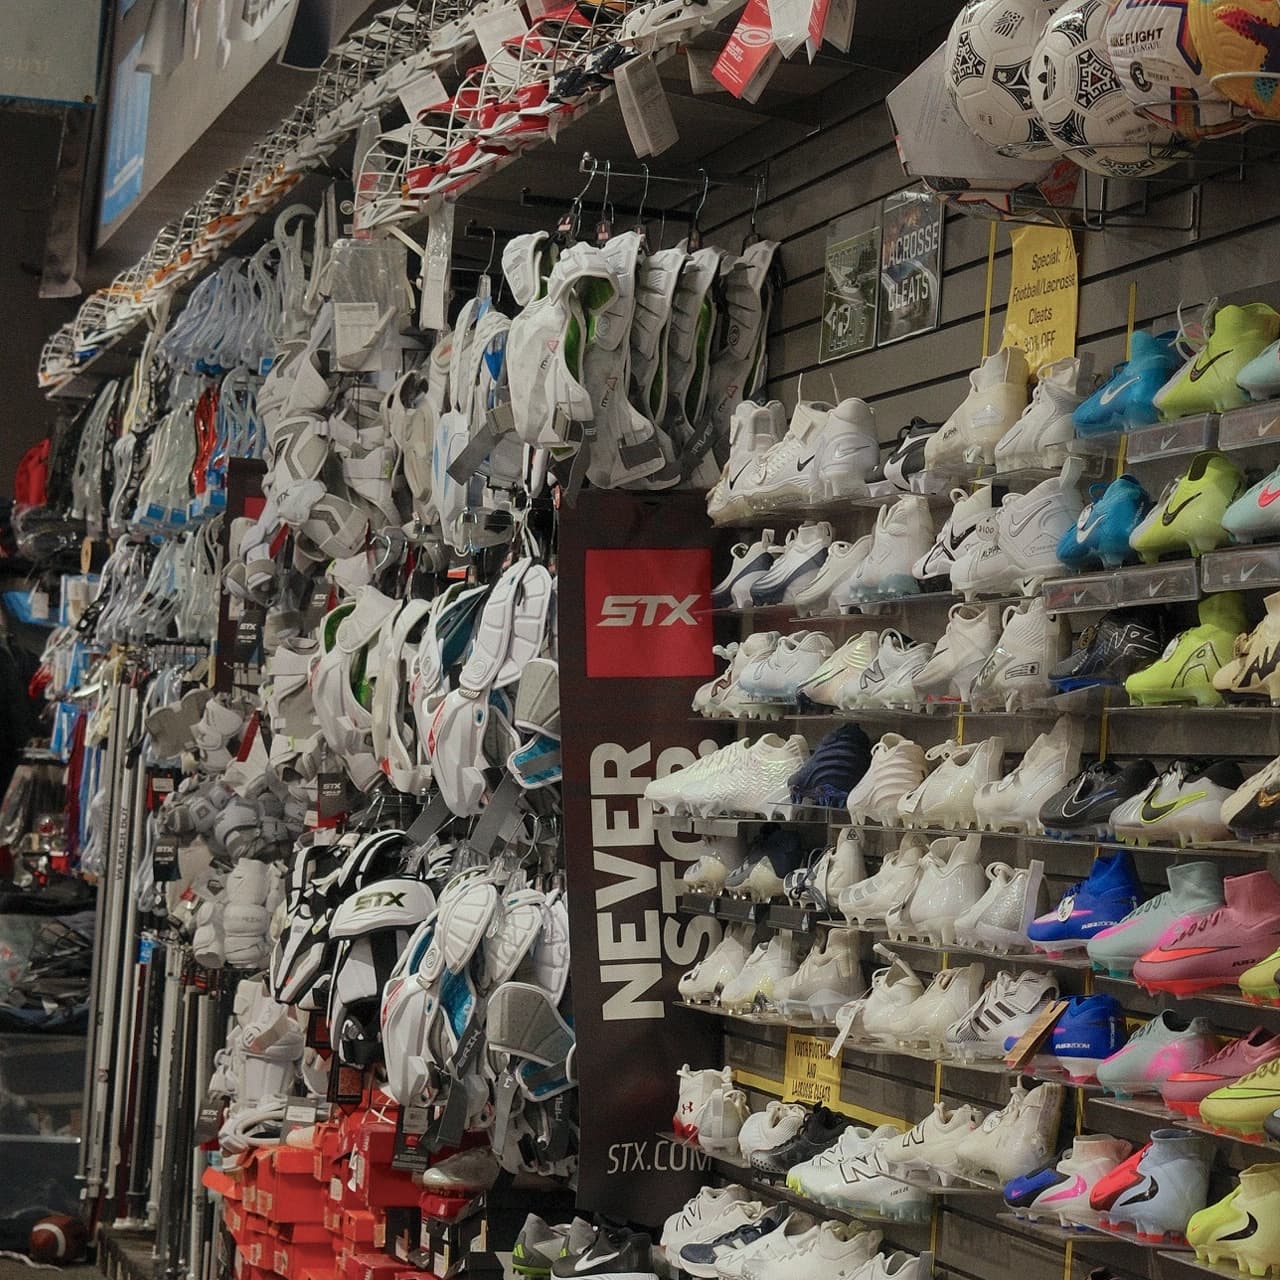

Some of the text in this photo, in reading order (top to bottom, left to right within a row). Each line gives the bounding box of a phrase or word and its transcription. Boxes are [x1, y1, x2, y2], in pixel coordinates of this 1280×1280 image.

[1125, 27, 1164, 46] FLIGHT
[881, 222, 939, 270] LACROSSE
[887, 271, 929, 312] CLEATS
[1028, 307, 1053, 326] Cleats
[1041, 330, 1056, 352] OFF
[596, 594, 702, 628] STX
[590, 741, 665, 1021] NEVER
[352, 891, 408, 913] STX
[806, 1063, 817, 1079] AND
